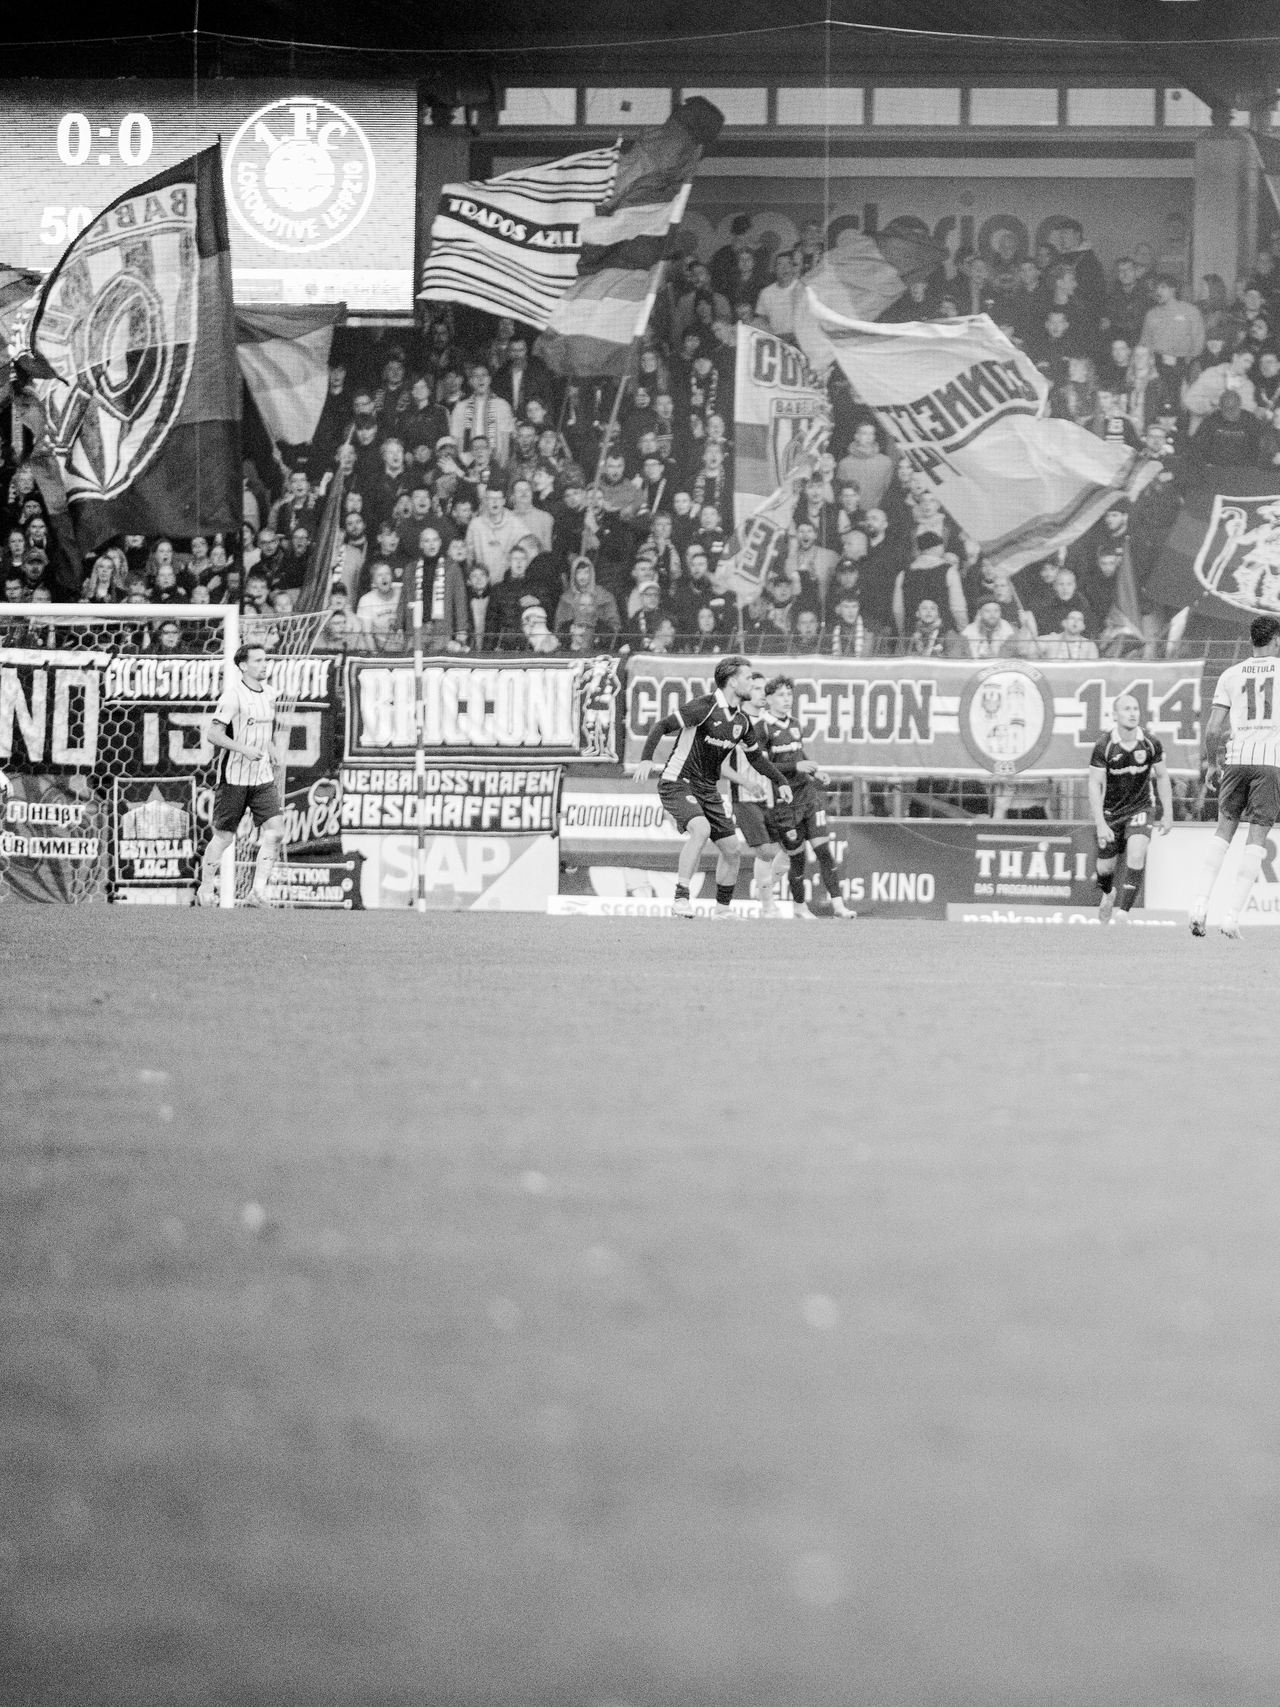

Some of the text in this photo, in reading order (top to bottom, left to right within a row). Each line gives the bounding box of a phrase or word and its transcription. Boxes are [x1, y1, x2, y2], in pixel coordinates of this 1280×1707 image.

[56, 112, 154, 166] 0:0
[40, 206, 92, 244] 50
[1241, 664, 1275, 674] ADETULA
[1241, 677, 1274, 720] 11
[0, 833, 27, 857] ÜR
[872, 871, 935, 903] KINO
